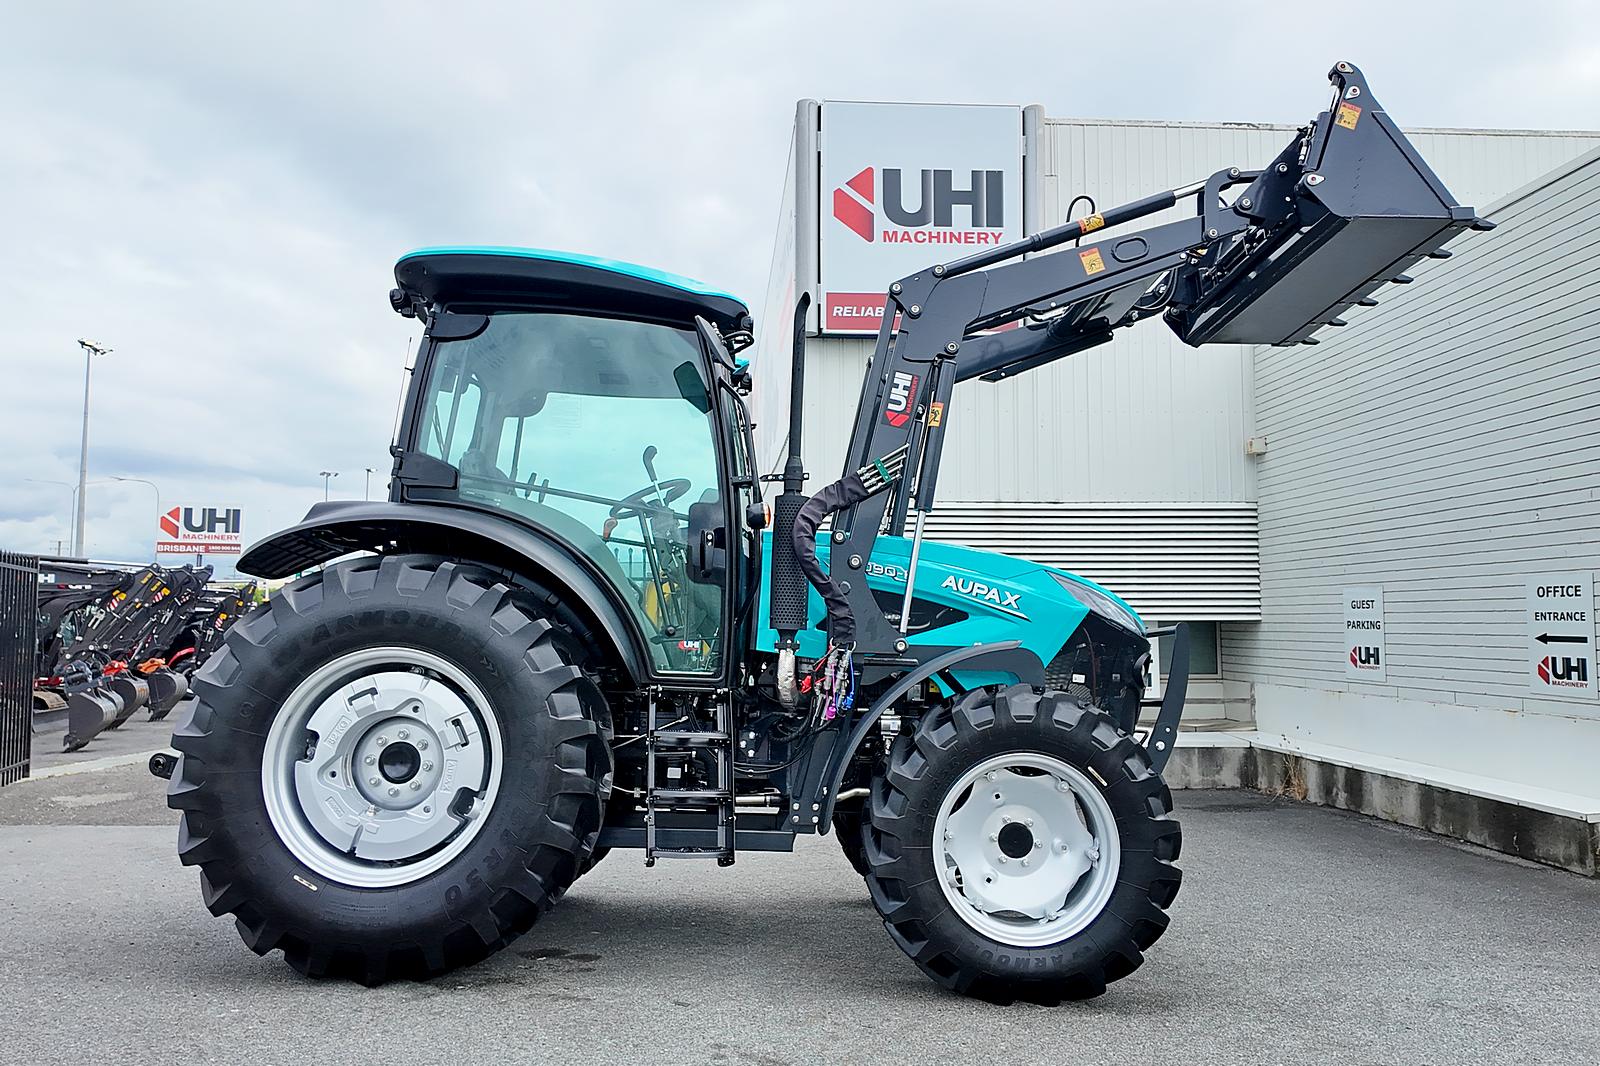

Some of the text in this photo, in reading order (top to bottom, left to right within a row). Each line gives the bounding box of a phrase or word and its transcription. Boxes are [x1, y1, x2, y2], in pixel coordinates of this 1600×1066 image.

[882, 168, 1003, 228] UHI
[882, 230, 1003, 244] MACHINERY
[832, 305, 901, 317] RELIAB
[887, 371, 913, 412] UHI
[184, 507, 241, 533] UHI
[183, 533, 240, 541] MACHINERY
[157, 544, 206, 553] BRISBANE
[941, 575, 1021, 609] AUPAX
[1536, 585, 1582, 598] OFFICE
[1350, 600, 1375, 609] GUEST
[1534, 611, 1586, 622] ENTRANCE
[1346, 620, 1381, 630] PARKING
[1358, 646, 1380, 665] UHI
[1551, 656, 1588, 682] UHI
[1551, 679, 1588, 689] MACHINERY
